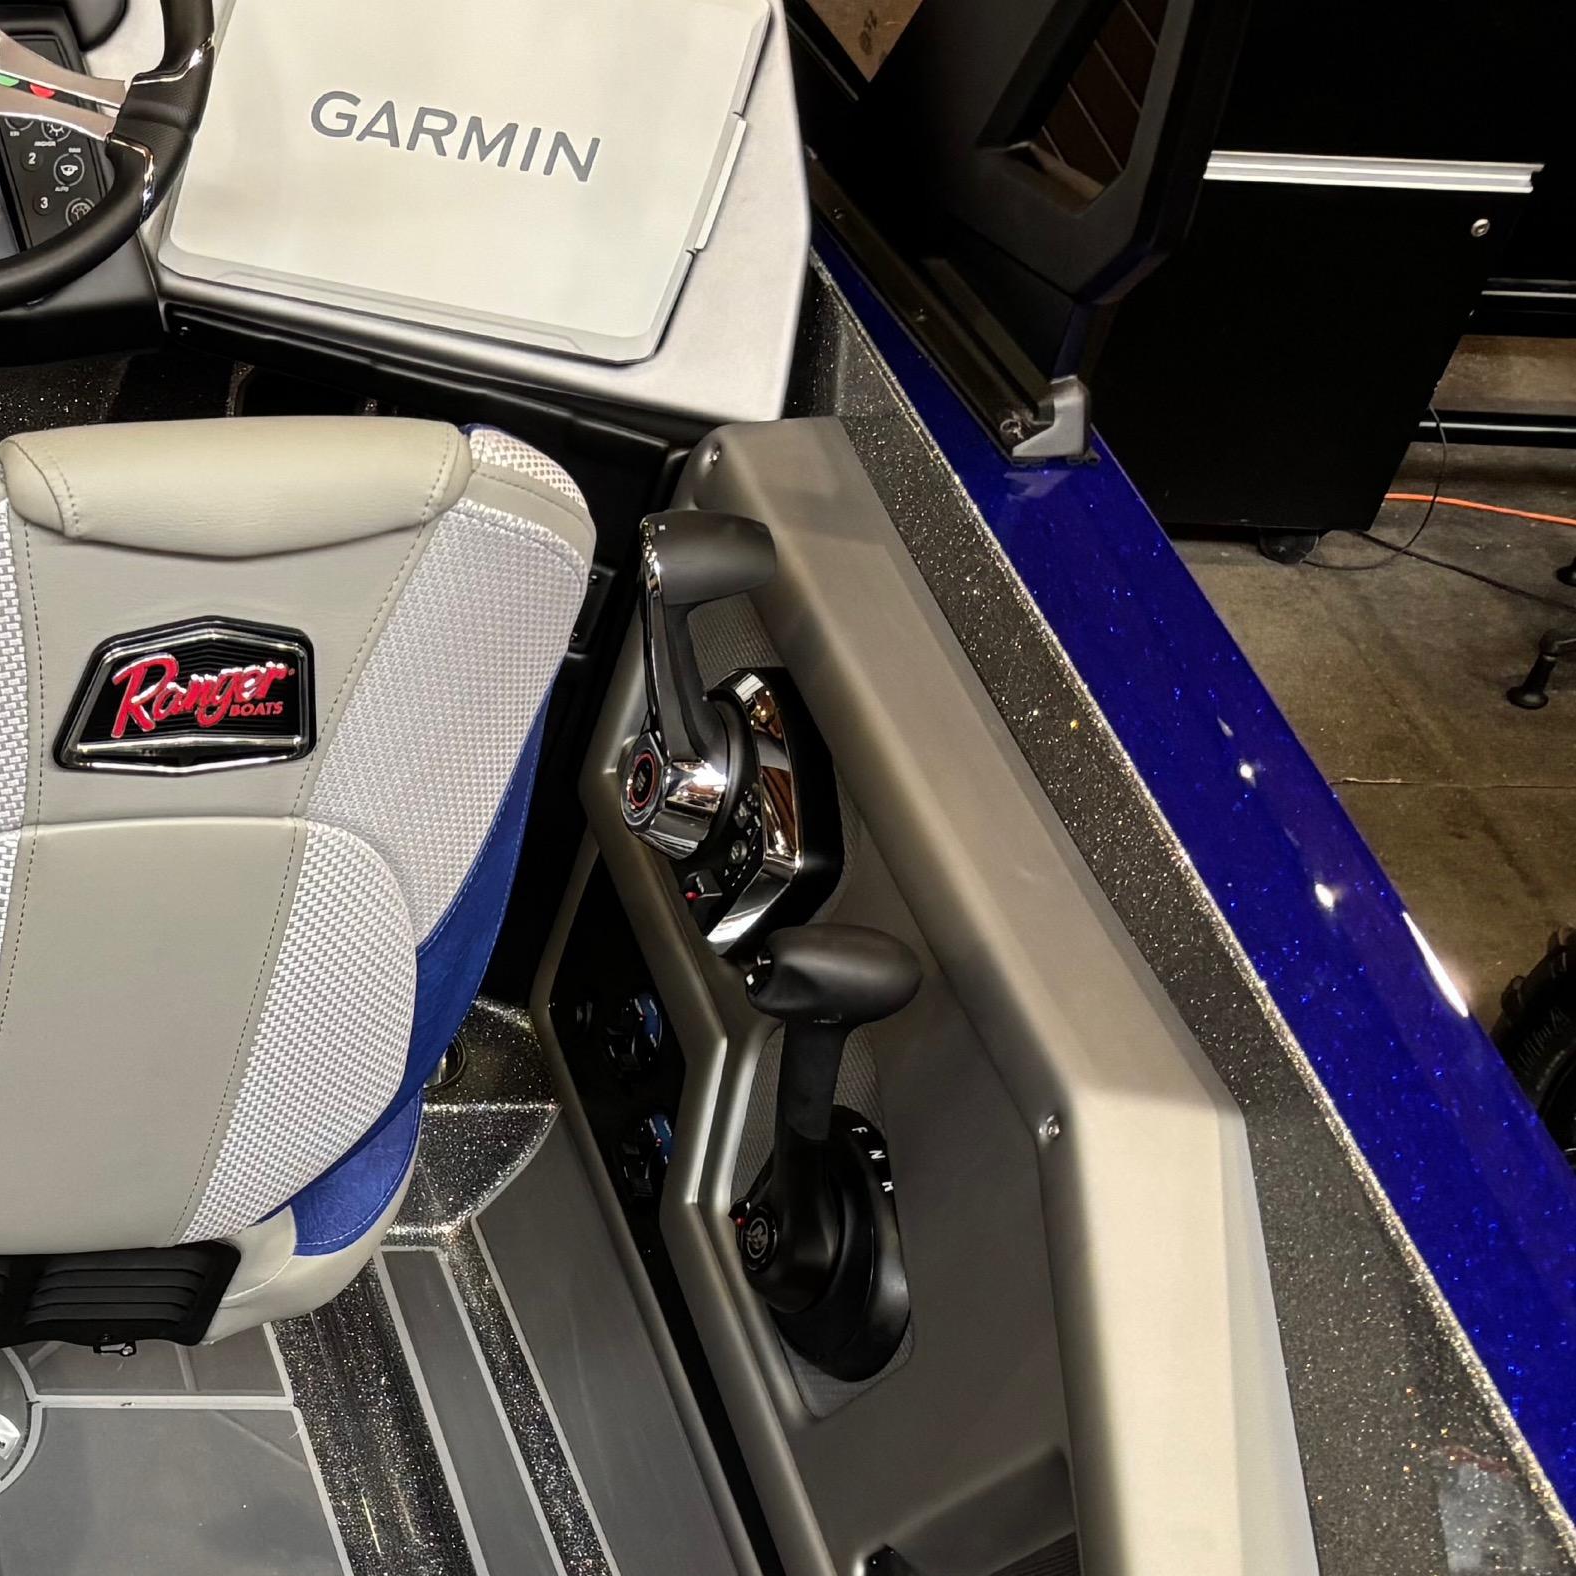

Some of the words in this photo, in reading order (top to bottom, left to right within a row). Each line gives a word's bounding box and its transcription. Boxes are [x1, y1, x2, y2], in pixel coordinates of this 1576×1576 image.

[310, 90, 601, 183] GARMIN
[28, 152, 37, 165] 2
[40, 196, 49, 209] 3
[110, 652, 289, 738] Ranger
[229, 700, 284, 717] BOATS
